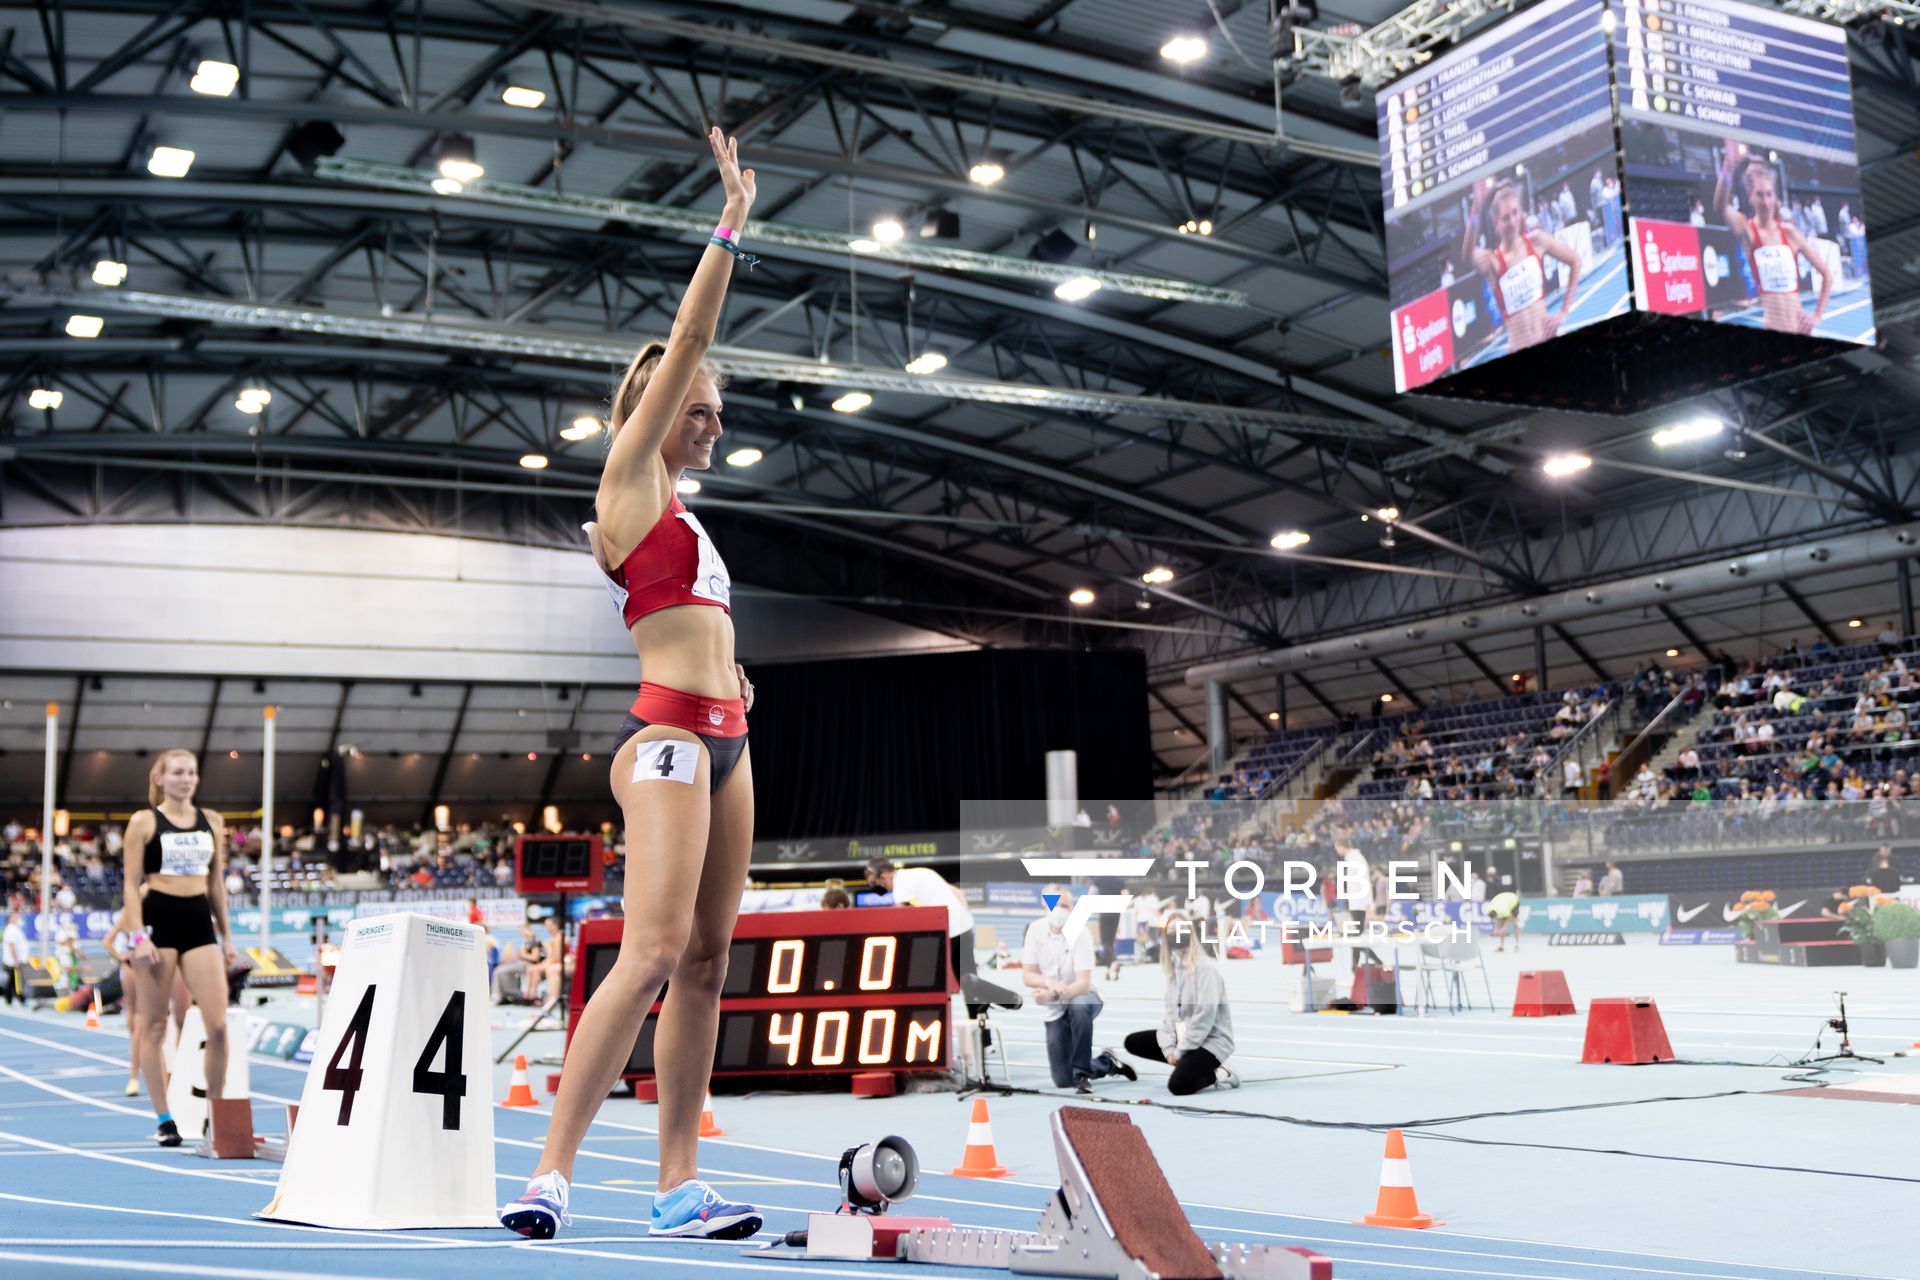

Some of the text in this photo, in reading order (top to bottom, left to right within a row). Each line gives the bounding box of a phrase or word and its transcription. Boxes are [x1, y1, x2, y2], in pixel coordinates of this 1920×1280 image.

[1443, 56, 1514, 103] MERGENTHALER
[1690, 64, 1720, 83] THIEL
[1443, 85, 1499, 122] LECHLEITNER
[1693, 84, 1738, 107] SCHWAB
[1696, 104, 1742, 127] SCHMIDT
[1444, 120, 1469, 140] THIEL
[1446, 131, 1486, 159] SCHWAB
[1447, 149, 1490, 179] SCHMIDT
[1660, 250, 1699, 277] Sparkasse
[1664, 278, 1694, 304] Leipzig
[1416, 316, 1449, 347] Sparkasse
[1419, 344, 1445, 373] Leipzig
[651, 744, 675, 777] 4
[174, 836, 200, 845] GLS
[425, 923, 463, 937] THÜRINGER
[1559, 934, 1616, 945] NOVAFON
[767, 935, 898, 994] 0.0
[767, 1009, 942, 1067] 400M
[322, 984, 377, 1126] 4
[413, 990, 467, 1130] 4
